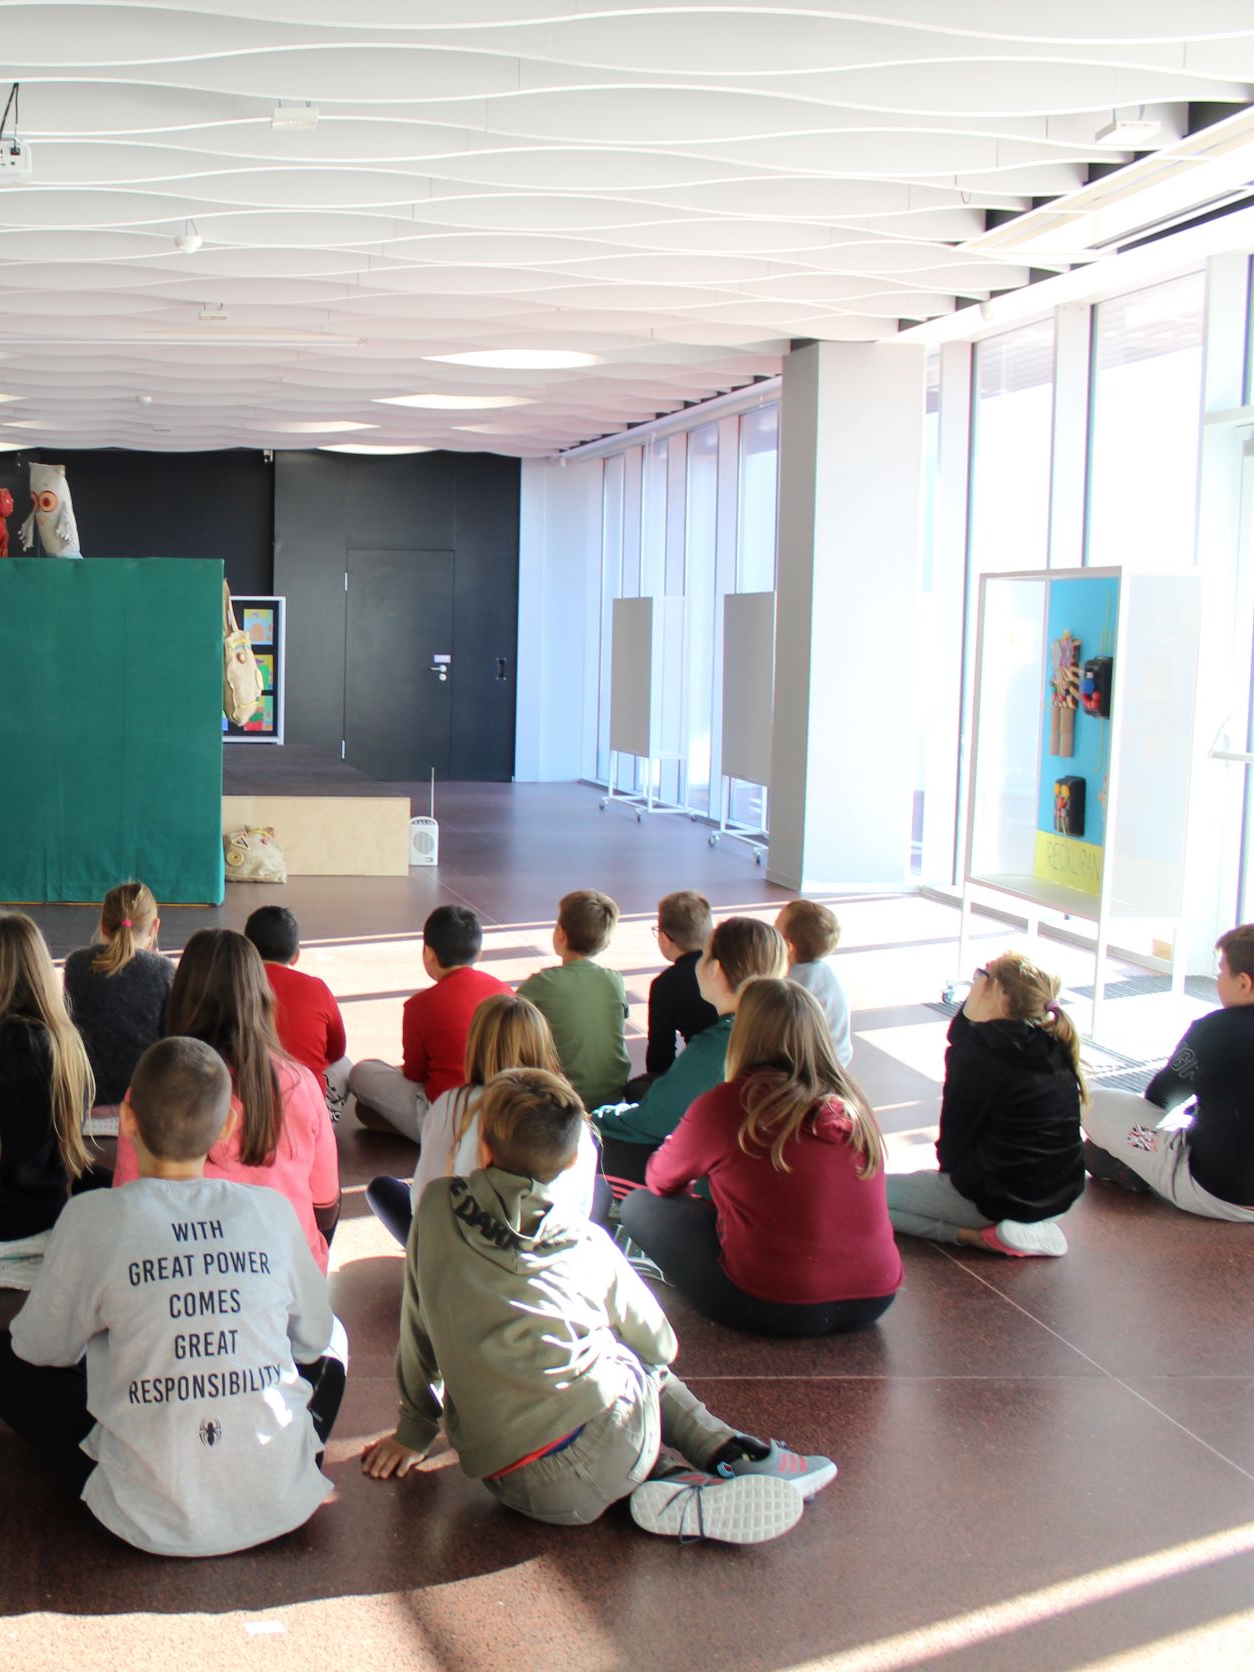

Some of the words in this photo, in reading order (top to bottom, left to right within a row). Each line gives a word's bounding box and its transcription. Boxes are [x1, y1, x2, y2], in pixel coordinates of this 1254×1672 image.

[171, 1219, 224, 1242] WITH
[128, 1254, 195, 1287] GREAT
[203, 1251, 271, 1275] POWER
[169, 1289, 241, 1319] COMES
[174, 1329, 238, 1360] GREAT
[128, 1363, 282, 1405] RESPONSIBILITY
